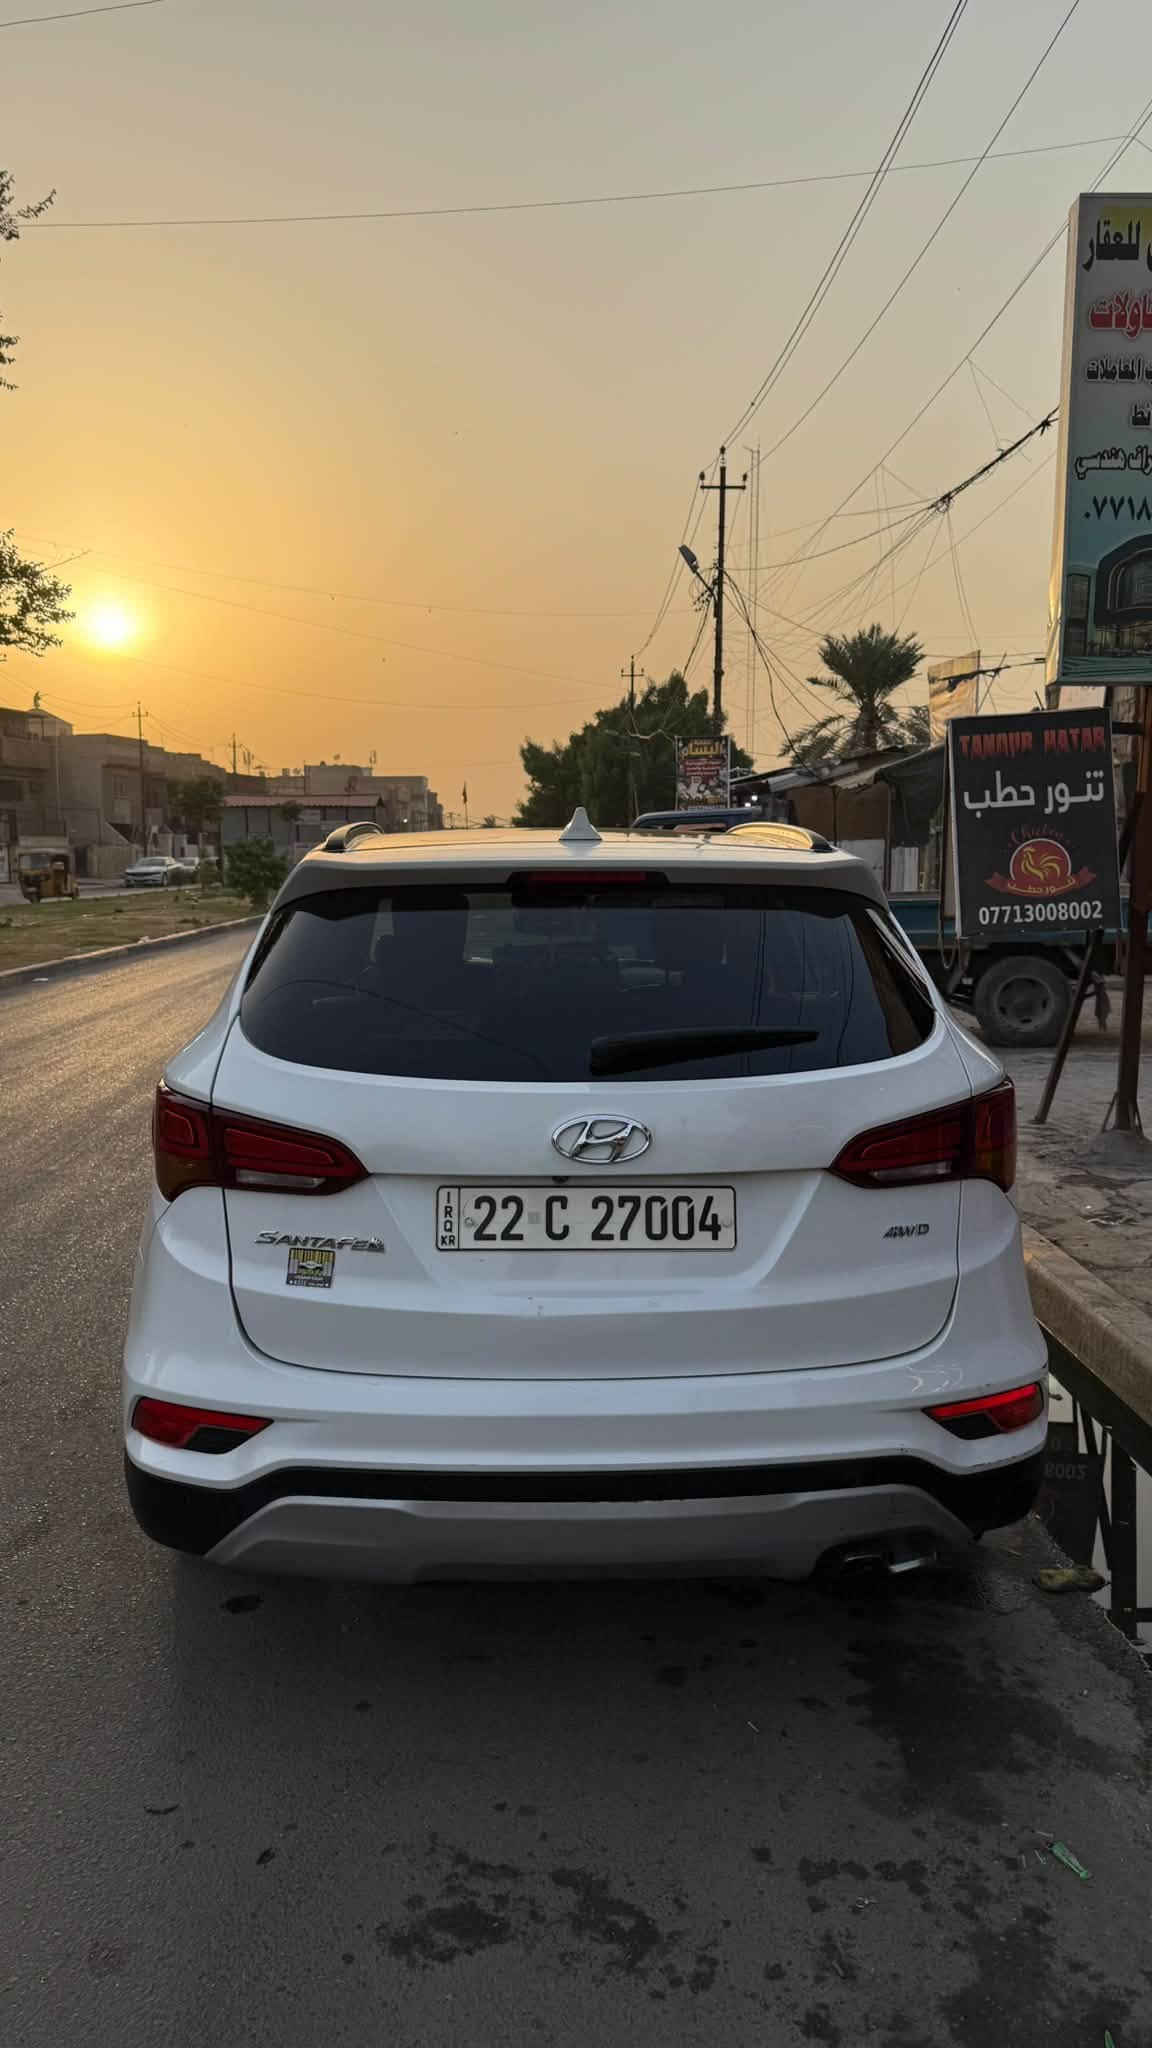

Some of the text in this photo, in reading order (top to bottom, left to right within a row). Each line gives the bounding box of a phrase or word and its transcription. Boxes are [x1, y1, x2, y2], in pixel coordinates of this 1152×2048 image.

[963, 770, 1104, 819] تنور حطب
[978, 900, 1103, 925] 07713008002
[473, 1195, 722, 1241] 22 C 27004
[254, 1230, 337, 1249] SANTA
